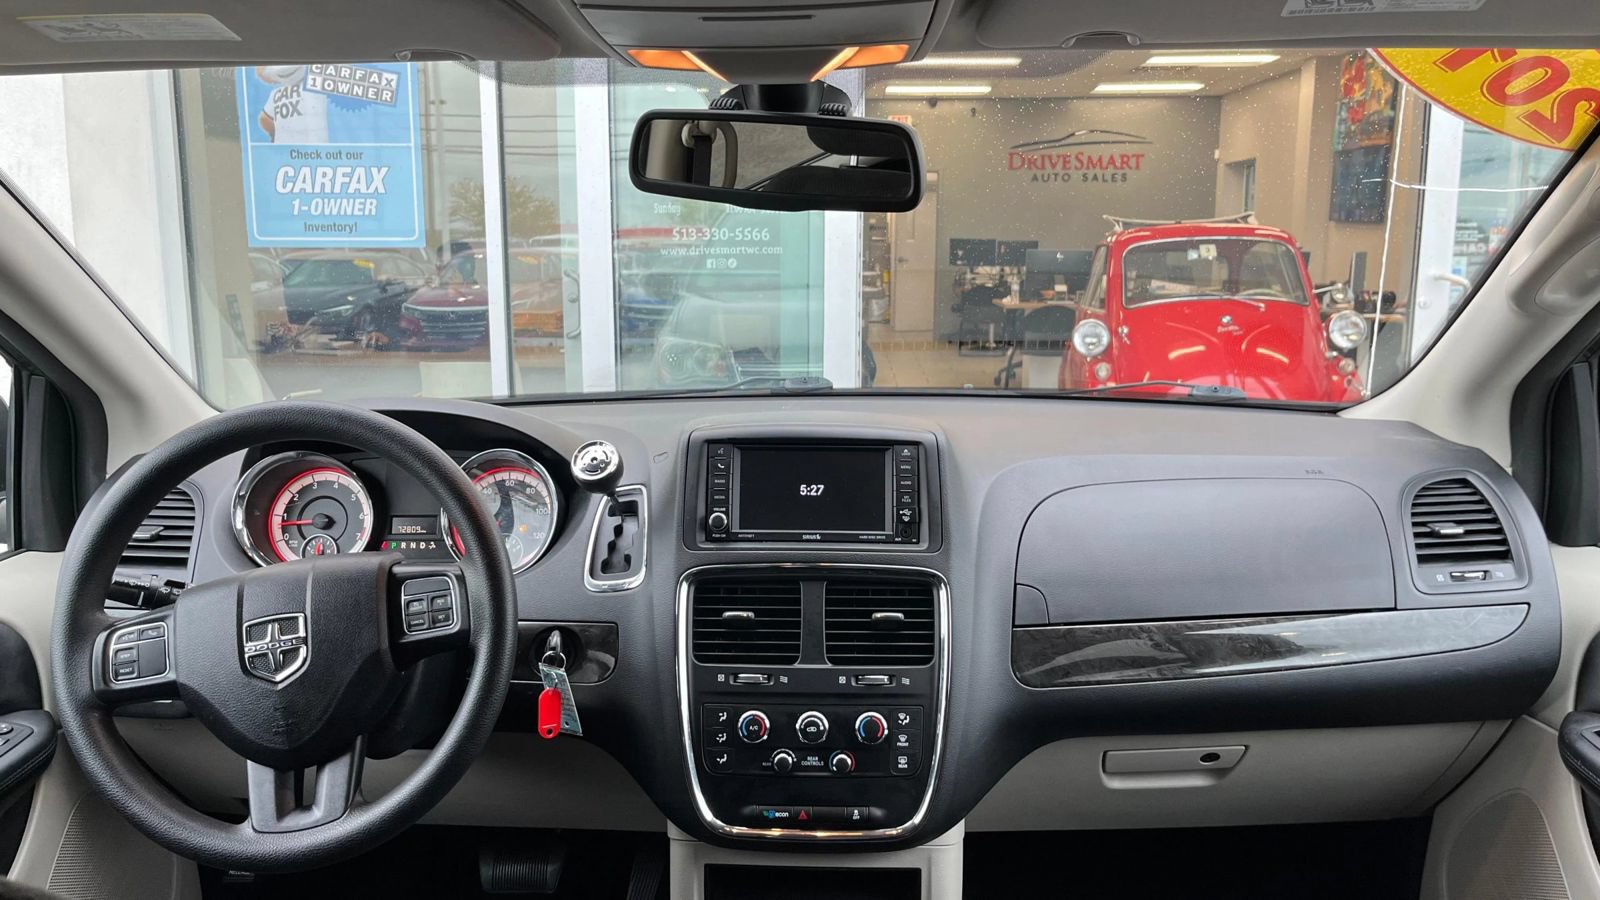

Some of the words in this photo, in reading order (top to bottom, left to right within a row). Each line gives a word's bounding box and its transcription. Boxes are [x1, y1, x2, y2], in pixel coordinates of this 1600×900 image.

[312, 64, 395, 88] CARFAX
[273, 85, 301, 104] CAR
[274, 100, 303, 121] FOX
[290, 149, 322, 160] Check
[325, 151, 343, 160] out
[346, 152, 363, 160] our
[275, 166, 390, 194] CARFAX
[1031, 173, 1072, 183] AUTO
[1082, 173, 1128, 183] SALES
[292, 198, 377, 216] 1-OWNER
[304, 222, 358, 233] Inventory!
[672, 227, 770, 240] 513-330-5566
[661, 246, 783, 256] www.drivesmartwc.com
[800, 485, 825, 496] 5:27
[244, 639, 304, 653] DODGE
